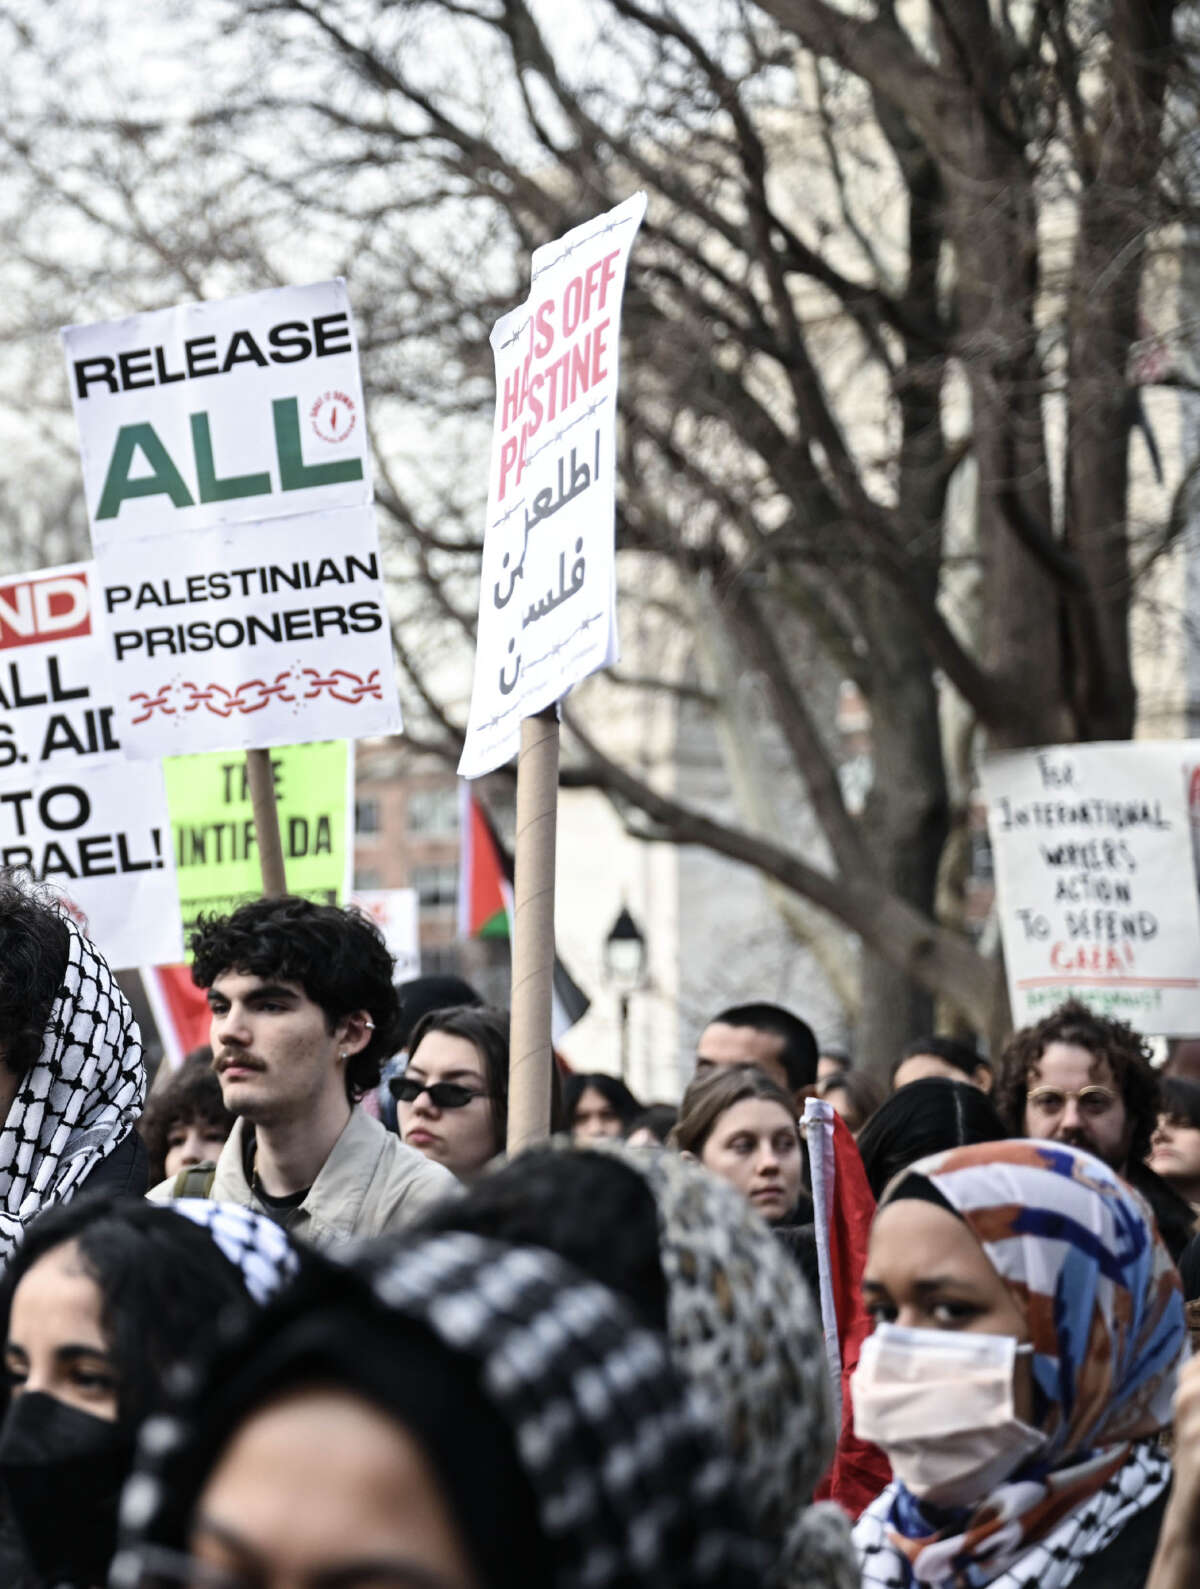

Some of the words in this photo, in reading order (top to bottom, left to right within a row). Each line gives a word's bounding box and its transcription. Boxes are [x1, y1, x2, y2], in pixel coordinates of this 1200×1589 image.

[562, 249, 620, 338] OFF
[73, 312, 352, 399] RELEASE
[499, 317, 610, 502] PASTINE
[94, 396, 364, 521] ALL
[104, 552, 380, 614] PALESTINIAN
[114, 601, 384, 661] PRISONERS
[0, 783, 92, 837] TO
[178, 814, 333, 868] INTIFDA
[1016, 908, 1050, 941] TO
[1066, 909, 1159, 941] DEFEND
